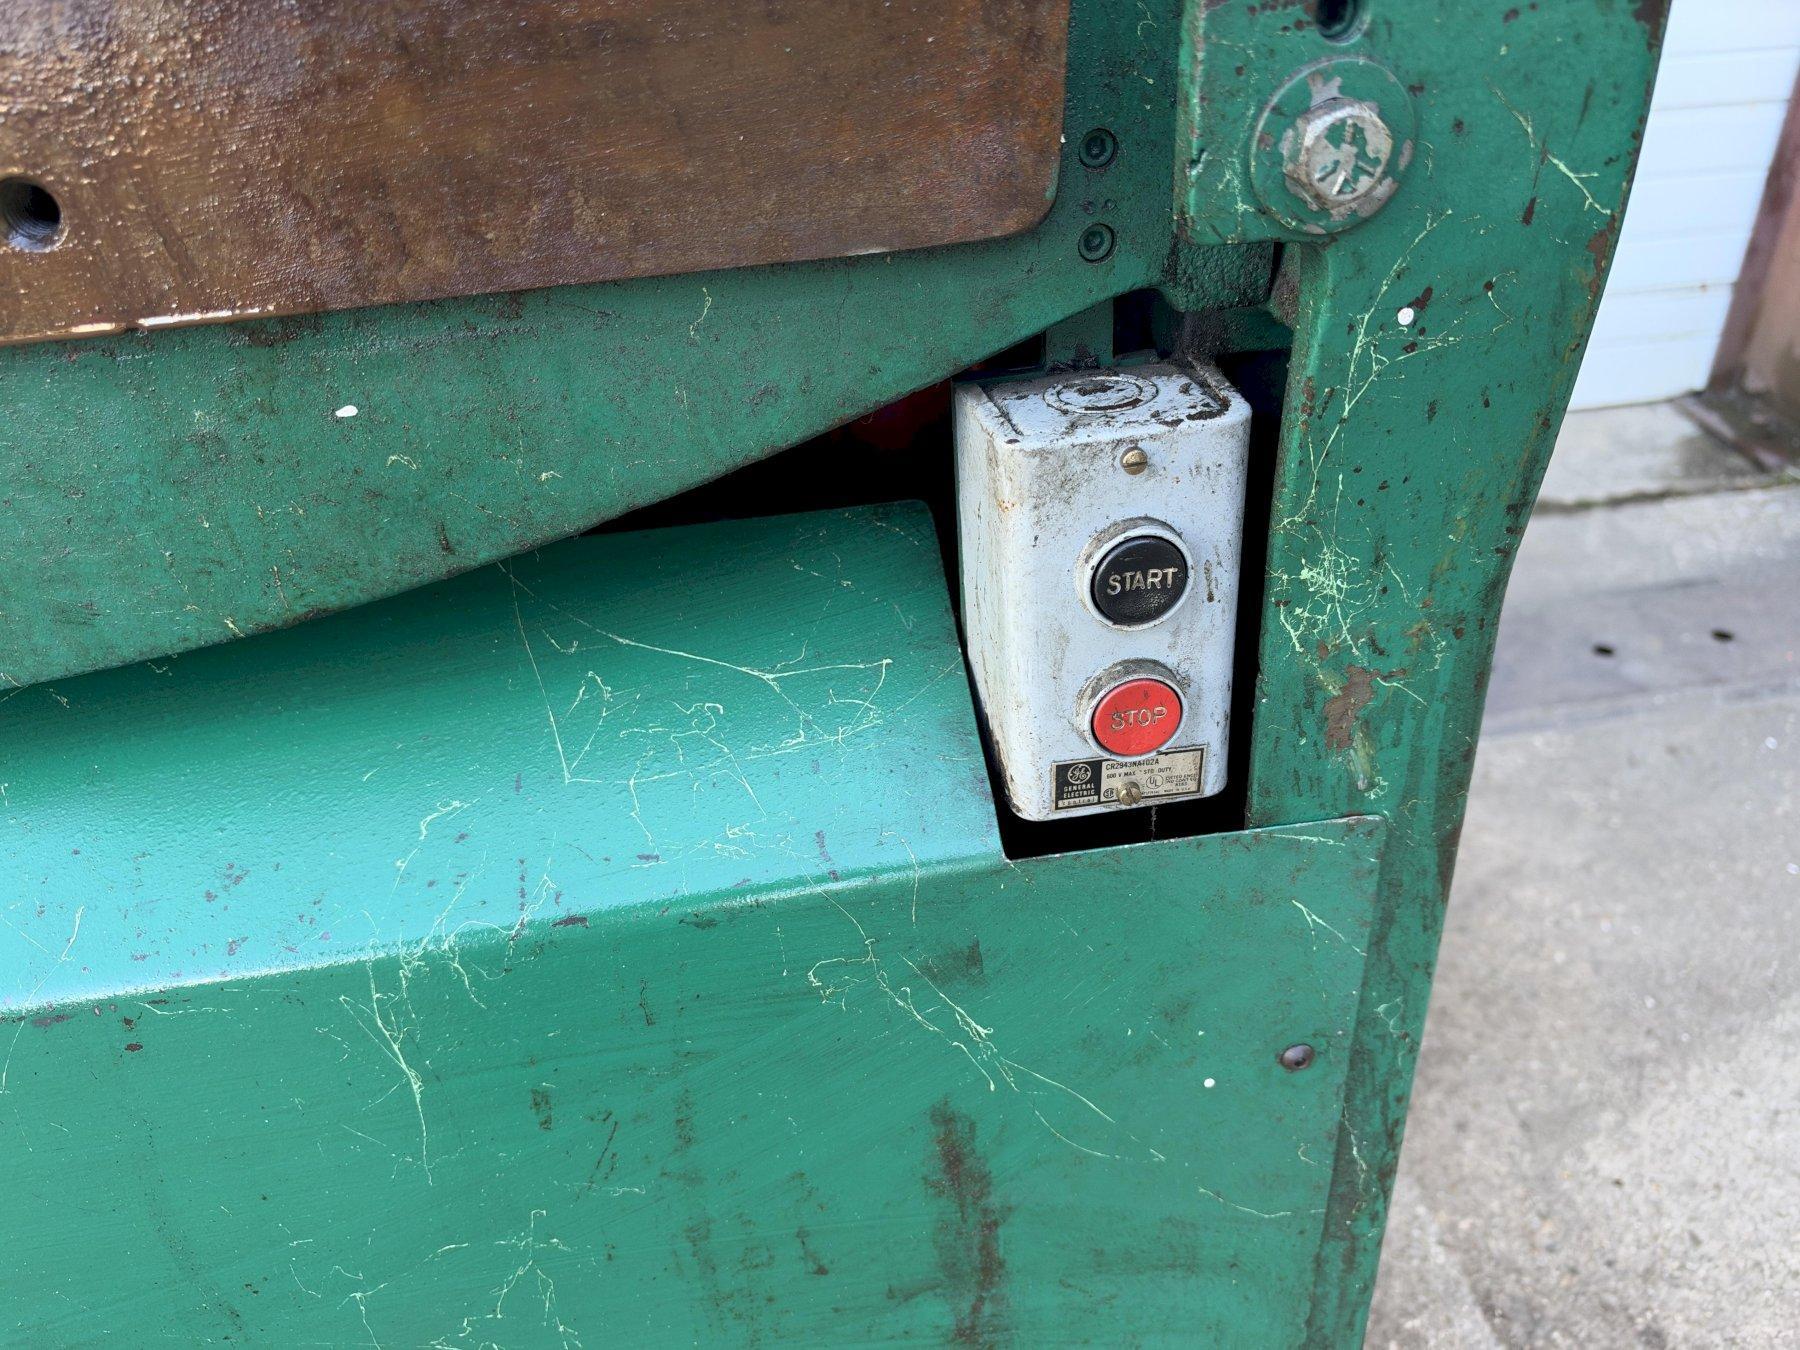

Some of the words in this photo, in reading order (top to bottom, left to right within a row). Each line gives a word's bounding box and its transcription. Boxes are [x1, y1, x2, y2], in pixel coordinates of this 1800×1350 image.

[1107, 566, 1178, 596] START
[1110, 706, 1167, 730] STOP
[1063, 783, 1095, 792] GENERAL
[1063, 789, 1095, 799] ELECTRIC
